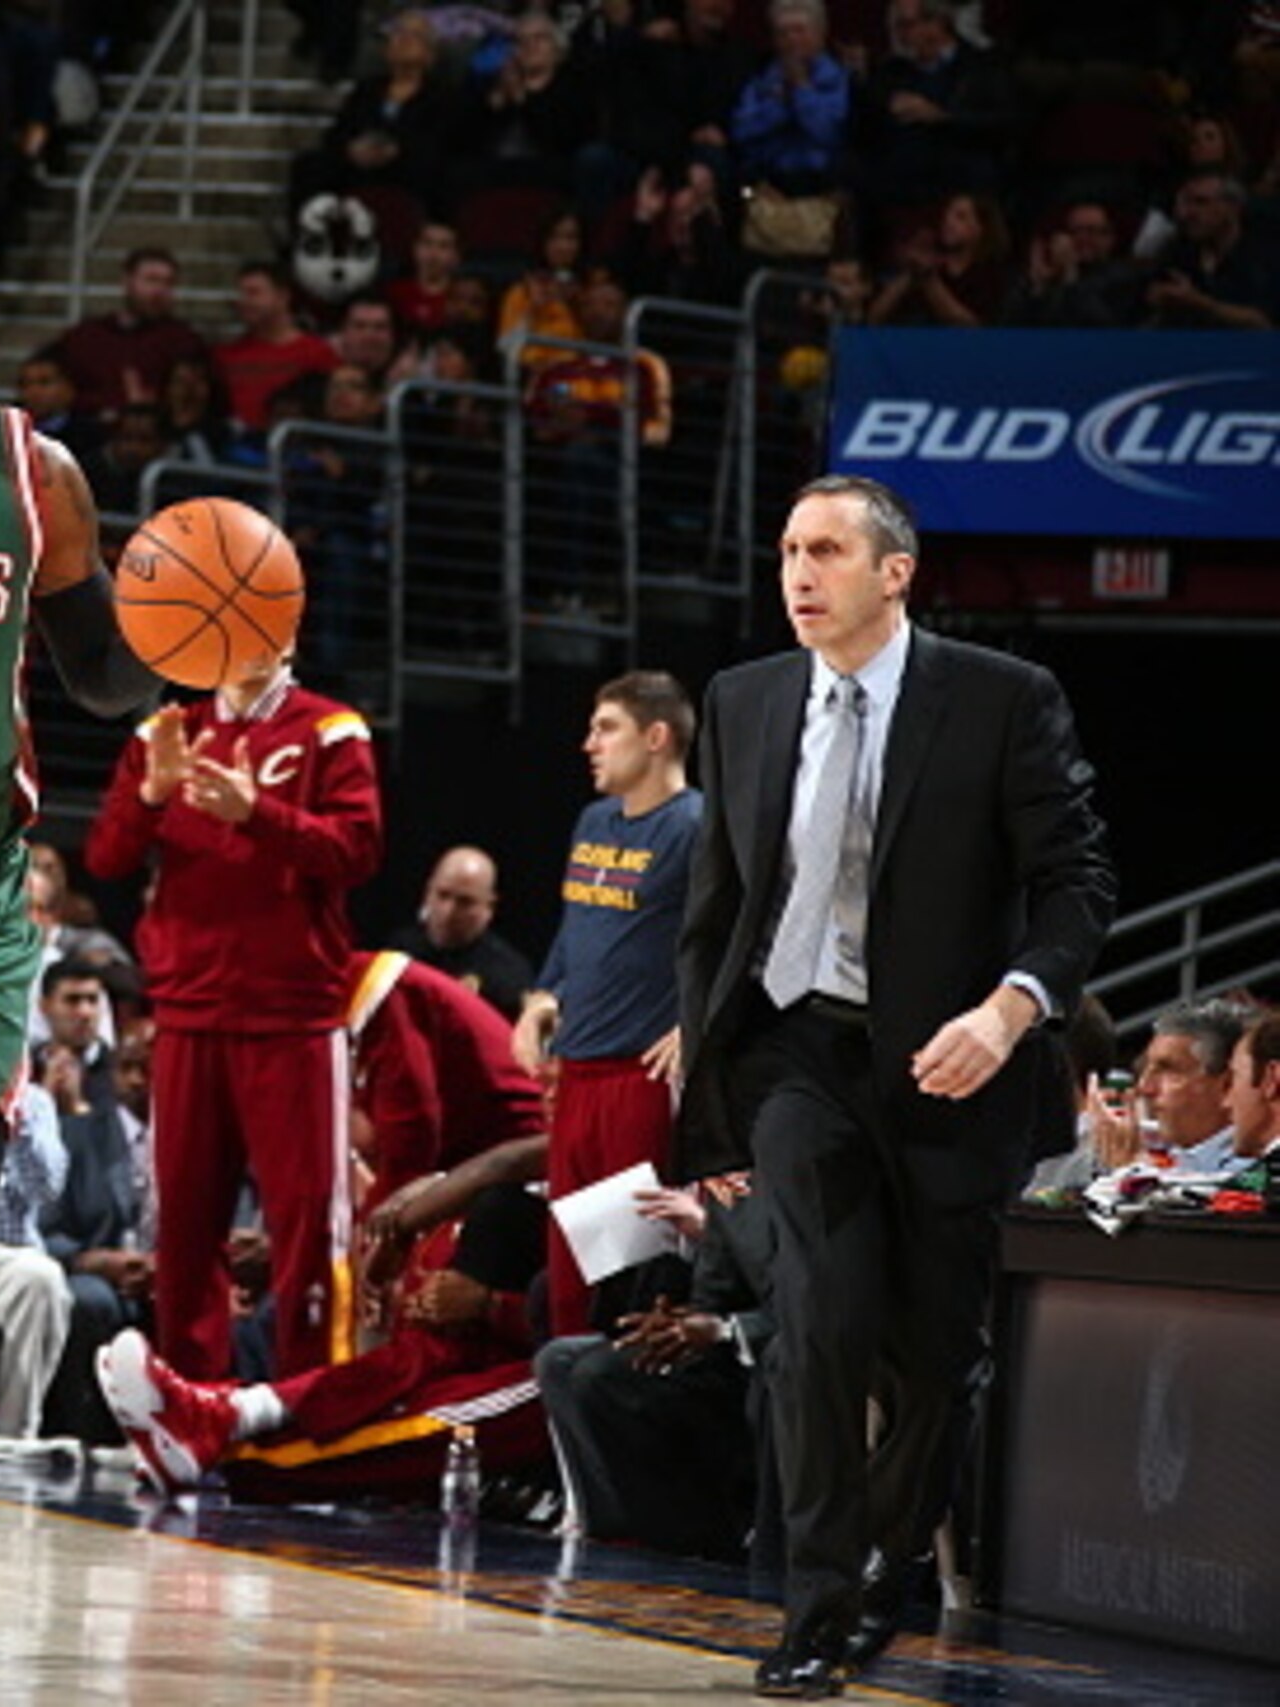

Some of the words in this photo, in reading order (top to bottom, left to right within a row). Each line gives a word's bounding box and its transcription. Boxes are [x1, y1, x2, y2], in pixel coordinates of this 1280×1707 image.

[842, 399, 1071, 461] BUD
[1116, 405, 1280, 465] LIG
[258, 744, 305, 785] C
